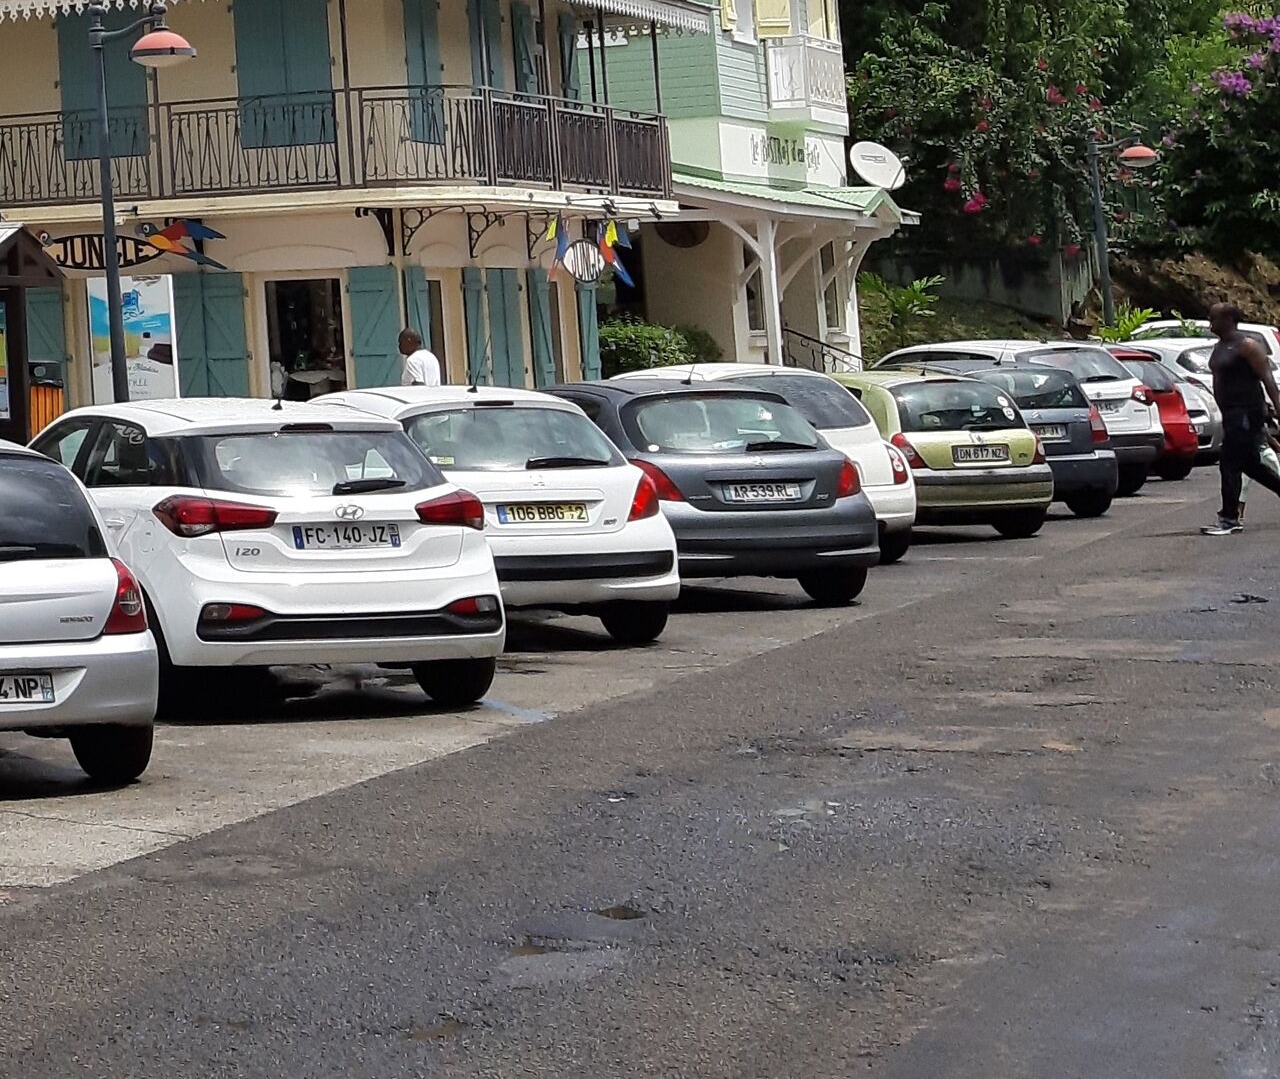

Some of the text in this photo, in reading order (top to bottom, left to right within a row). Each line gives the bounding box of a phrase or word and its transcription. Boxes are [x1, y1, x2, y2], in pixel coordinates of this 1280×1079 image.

[56, 236, 150, 267] JUNLE
[509, 506, 536, 521] 106
[537, 504, 565, 520] BBG
[304, 525, 388, 545] FC-140-JZ
